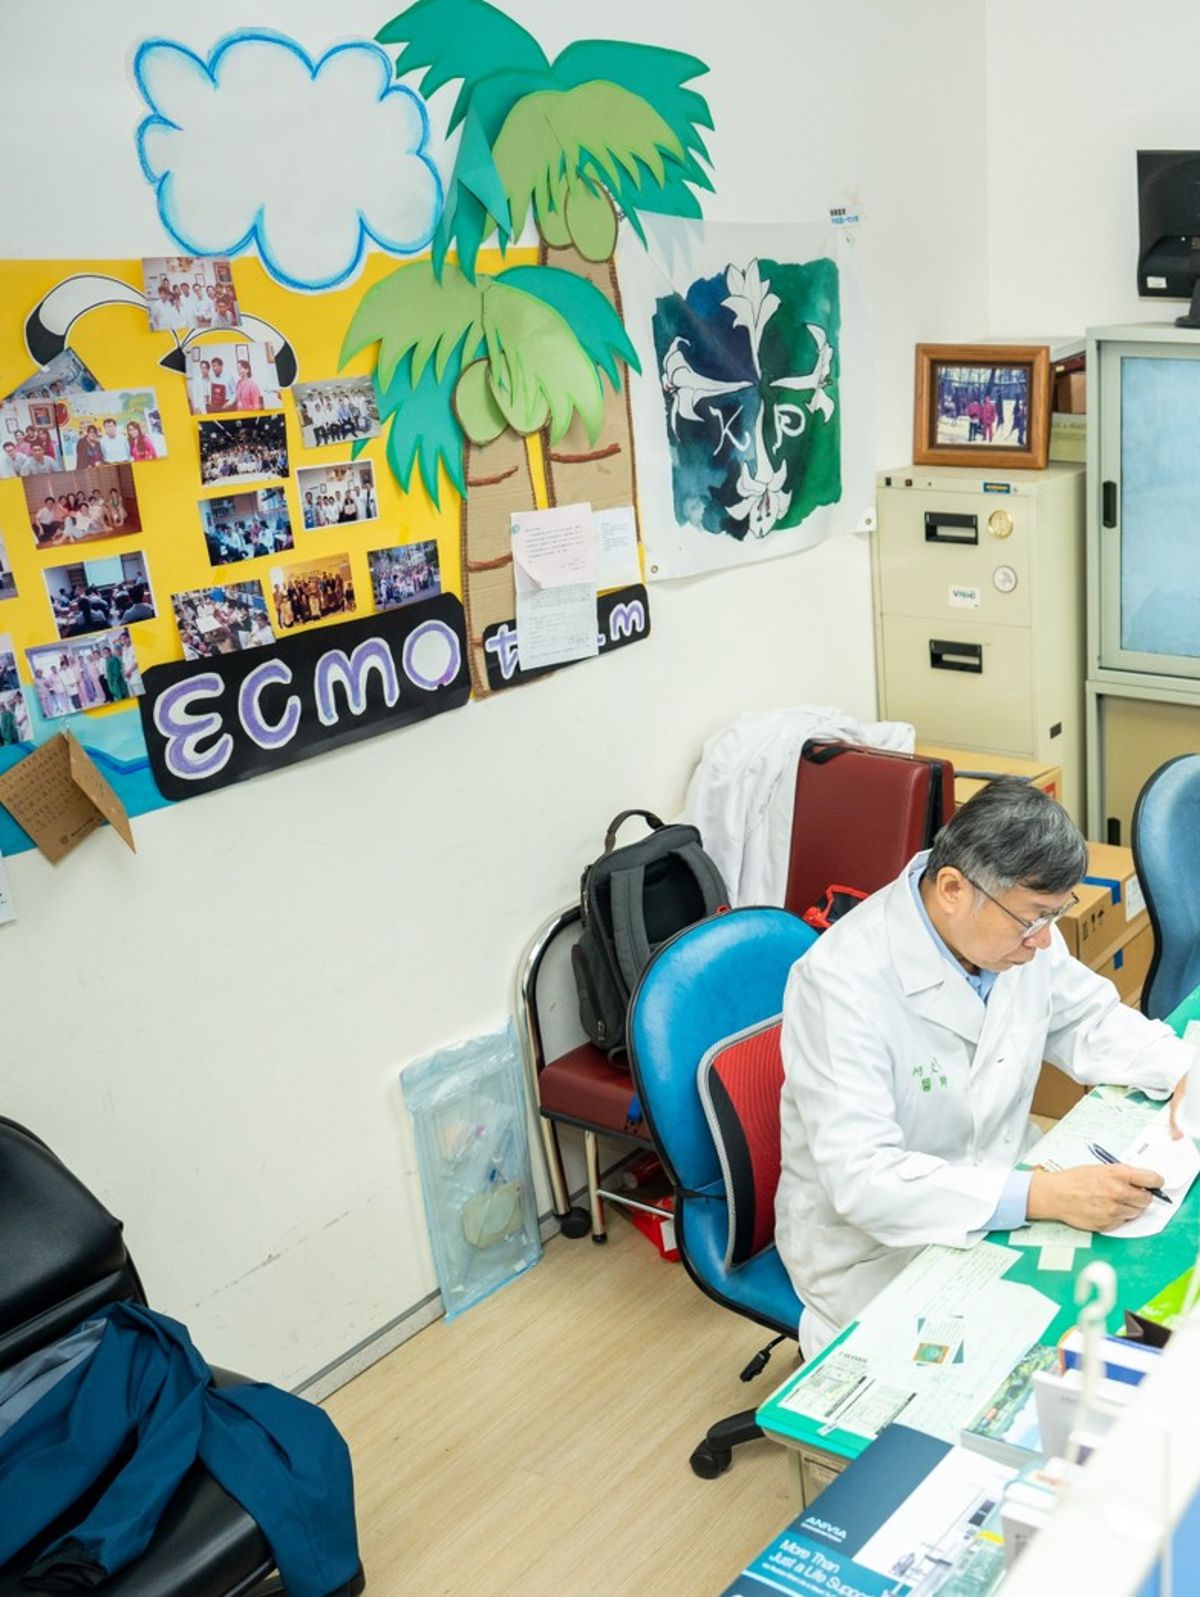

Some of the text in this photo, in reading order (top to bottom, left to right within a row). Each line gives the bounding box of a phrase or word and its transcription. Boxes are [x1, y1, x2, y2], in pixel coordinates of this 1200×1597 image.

[709, 403, 805, 456] K P
[153, 619, 461, 781] ECMO
[485, 599, 645, 680] tm
[768, 1551, 797, 1570] Just
[793, 1563, 805, 1574] a
[803, 1565, 827, 1584] Life
[779, 1539, 841, 1574] More Than
